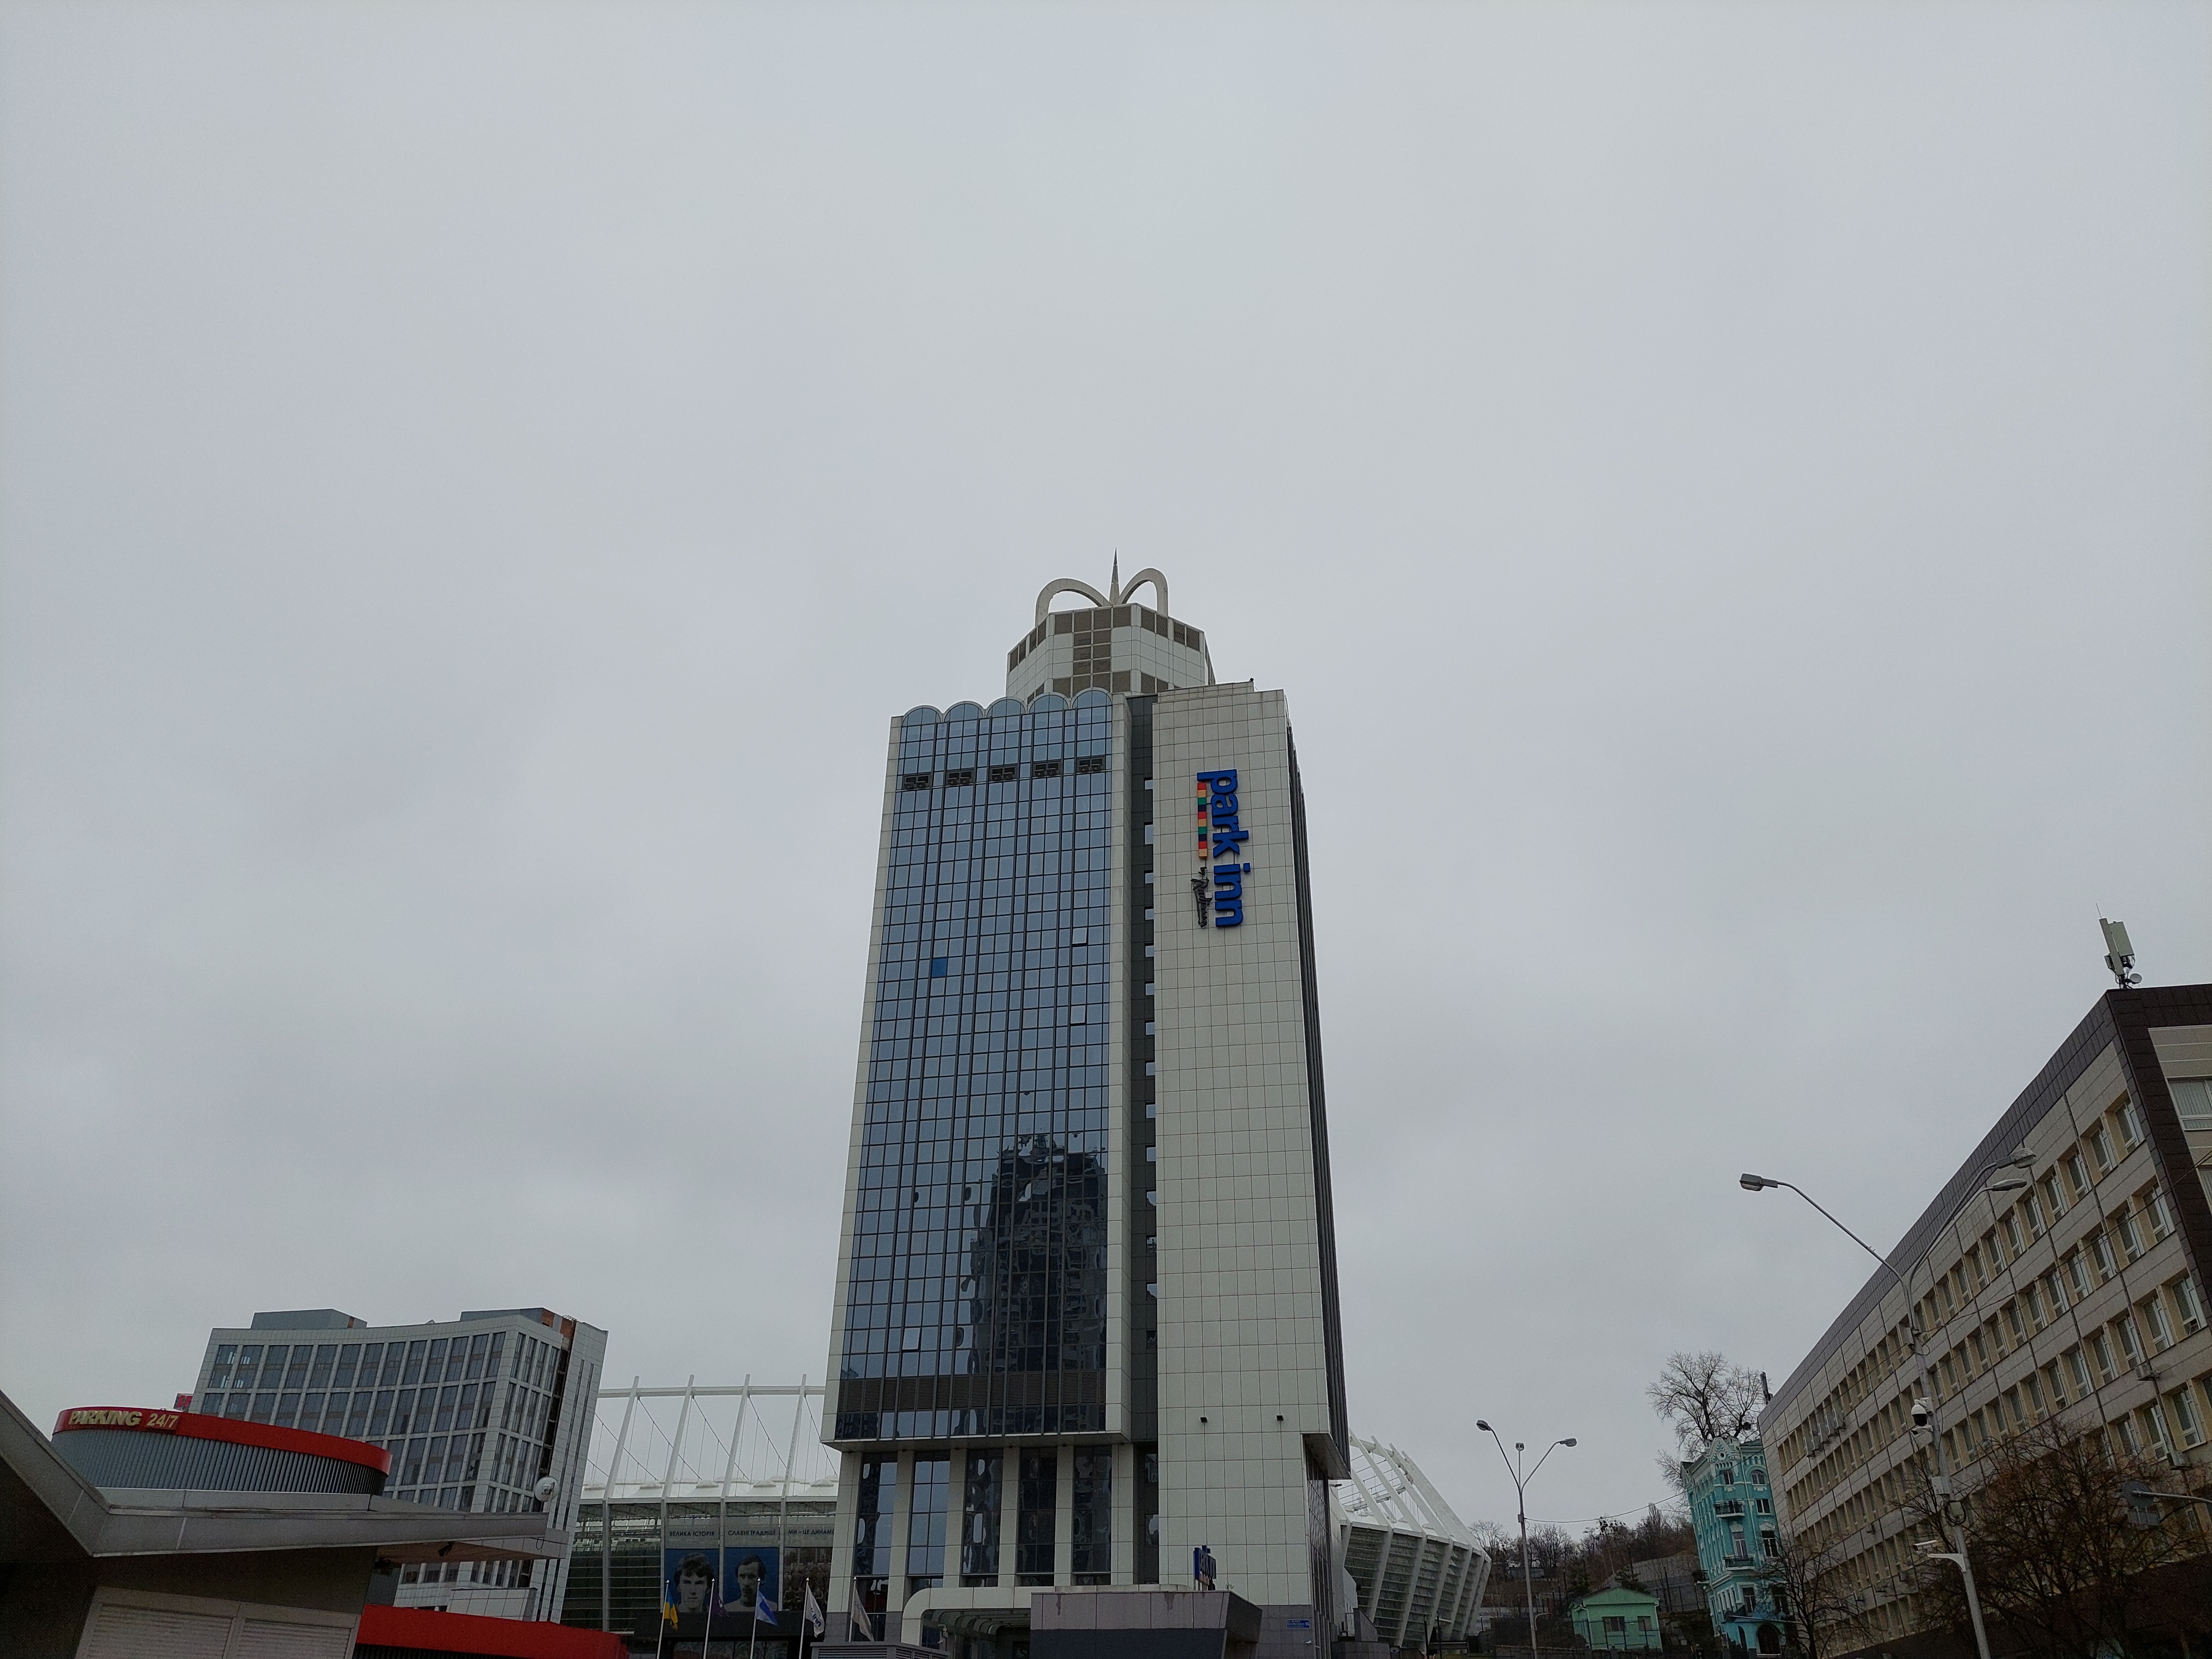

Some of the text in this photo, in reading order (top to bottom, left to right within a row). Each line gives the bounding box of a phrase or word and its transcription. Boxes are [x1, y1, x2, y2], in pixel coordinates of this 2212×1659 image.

[1197, 769, 1250, 927] park inn
[1191, 877, 1213, 928] Radisson
[68, 1410, 178, 1428] PARKING 24/7
